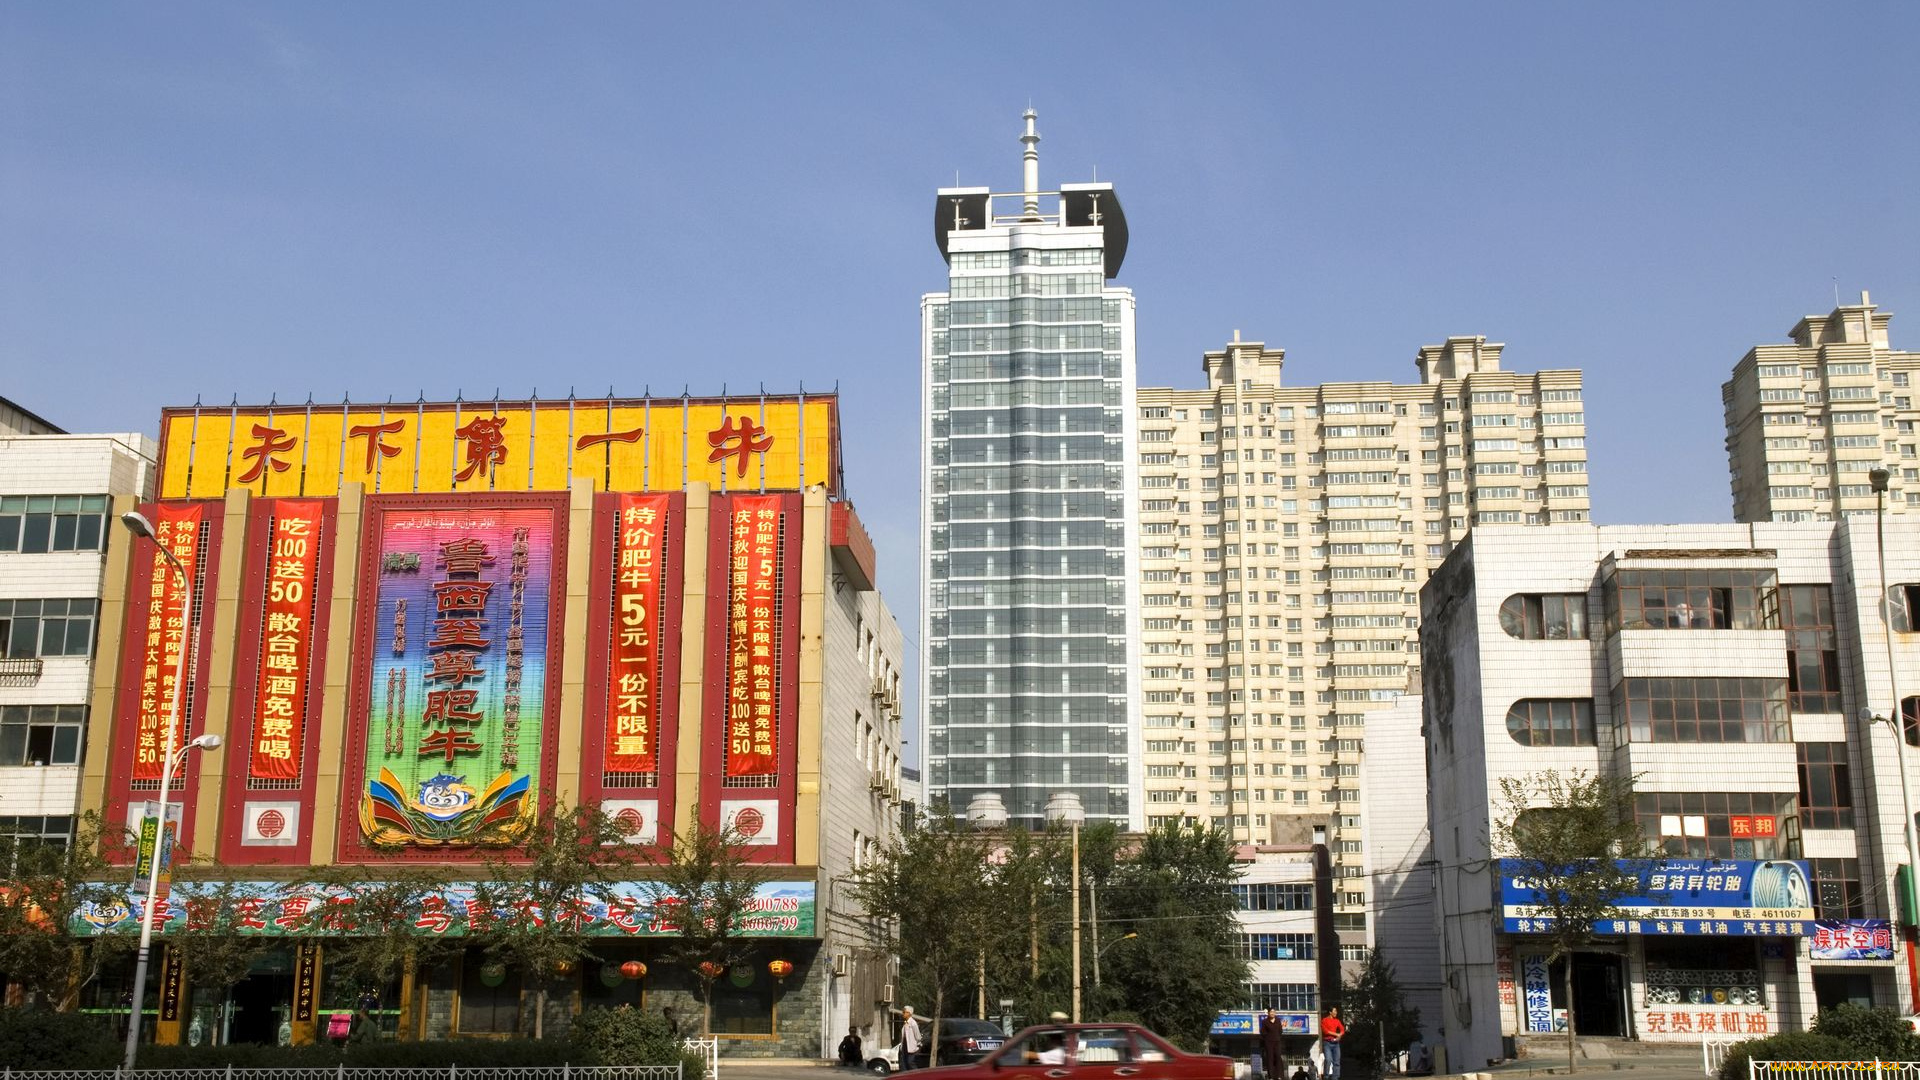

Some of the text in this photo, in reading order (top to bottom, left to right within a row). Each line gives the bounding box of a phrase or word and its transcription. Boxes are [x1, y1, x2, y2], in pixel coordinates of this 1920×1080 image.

[238, 415, 775, 483] 天下第一牛
[614, 506, 656, 755] 特价肥牛5元一份不限量
[733, 510, 752, 755] 庆中秋迎国庆激情大酬宾吃100送50
[138, 822, 156, 875] 轻骑兵
[1732, 818, 1773, 834] 乐邦
[1613, 920, 1641, 934] 钢圈
[1657, 921, 1685, 934] 电瓶
[1700, 921, 1728, 934] 机油
[1813, 927, 1891, 950] 娱乐空间
[1526, 954, 1551, 1033] 加冷媒修空调
[1647, 1011, 1768, 1034] 免费换机油
